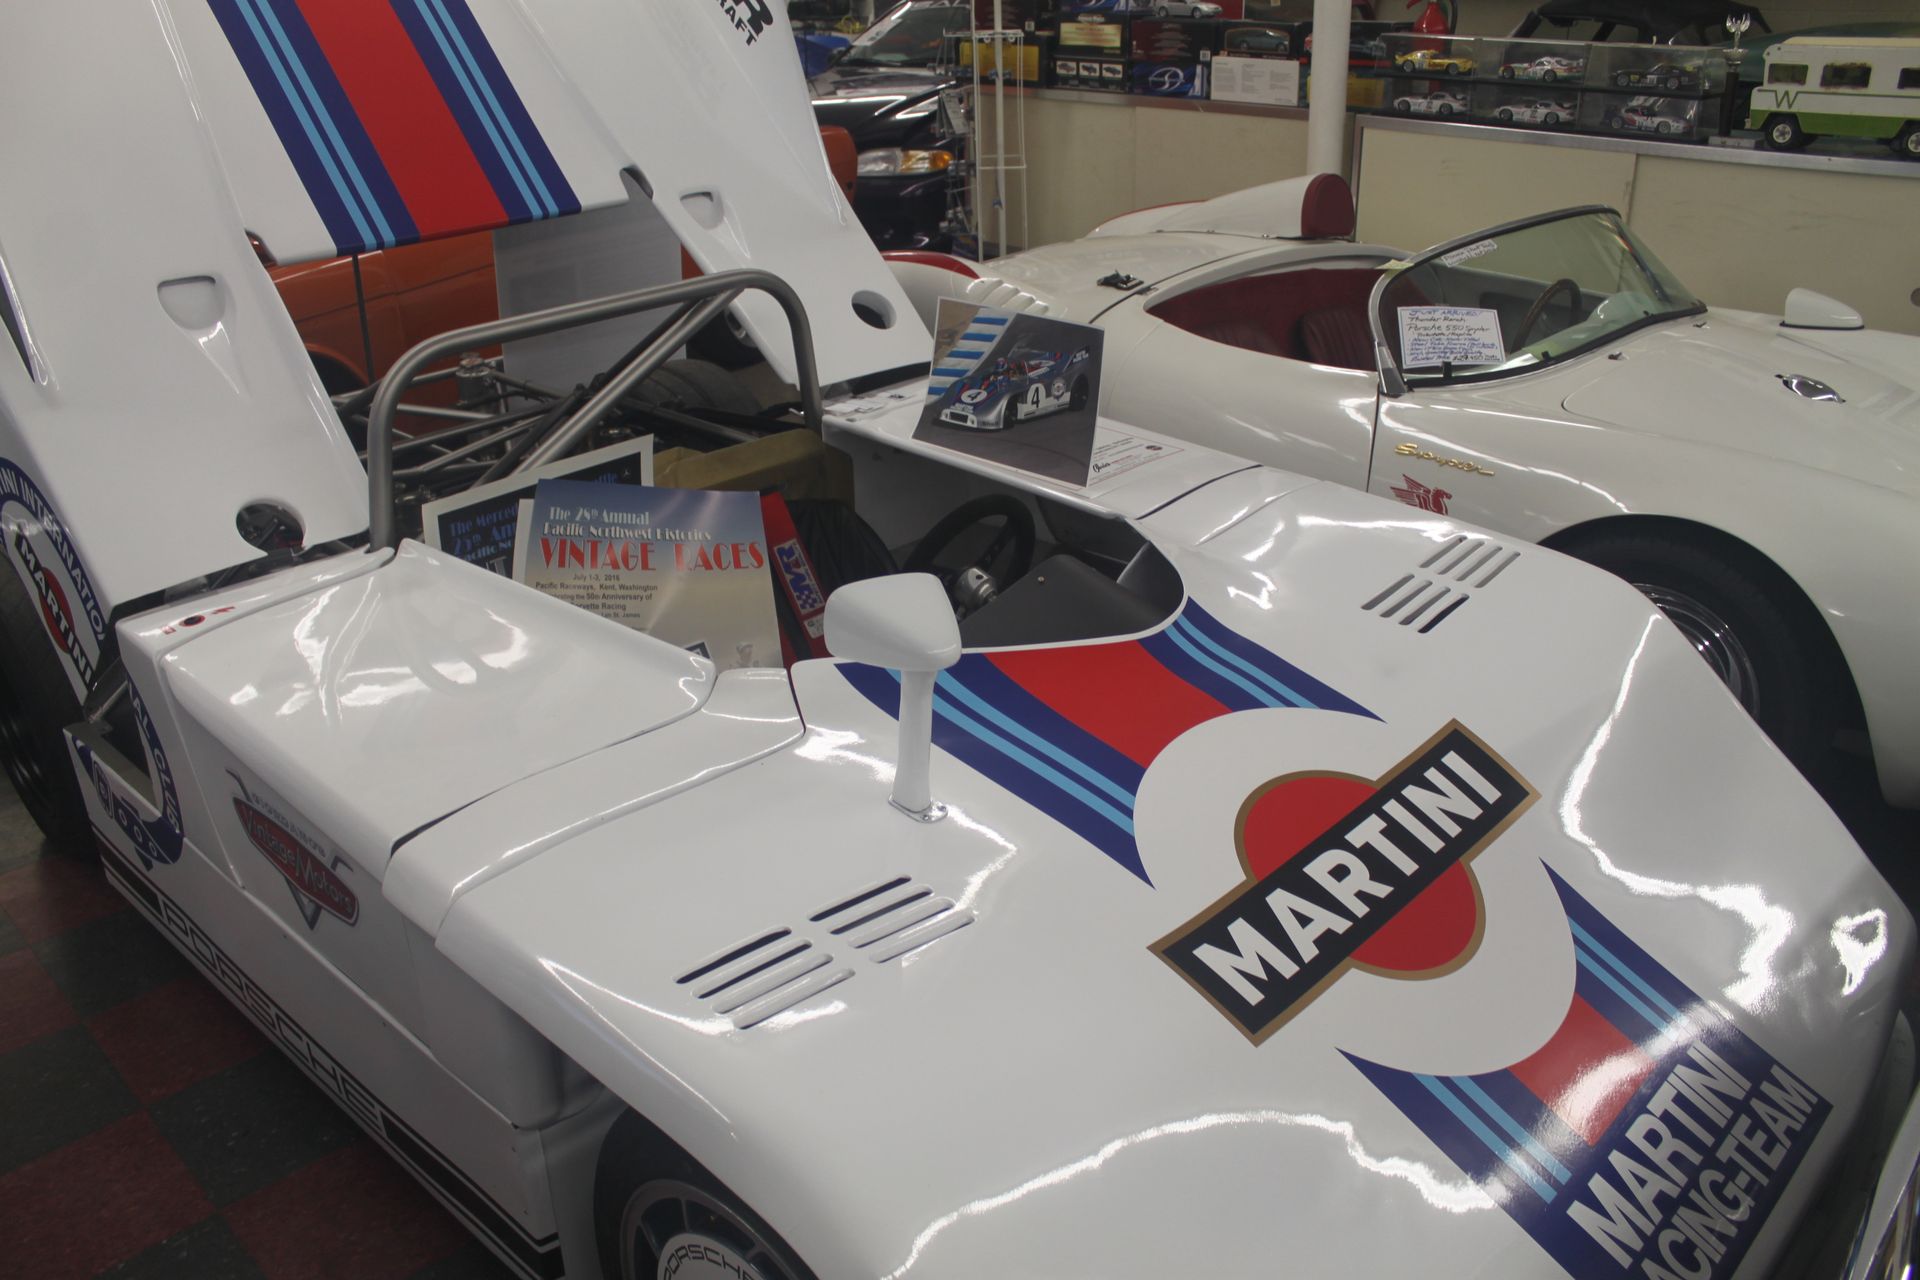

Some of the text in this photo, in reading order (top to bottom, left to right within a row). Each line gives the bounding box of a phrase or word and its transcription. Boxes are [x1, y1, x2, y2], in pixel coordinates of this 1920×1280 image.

[543, 521, 712, 541] Pacific Northwest Historics
[549, 506, 571, 520] The
[602, 508, 650, 525] Annual
[540, 538, 656, 571] VINTAGE
[674, 541, 764, 571] RACES
[535, 581, 557, 590] Pacific
[619, 584, 658, 593] Washington
[601, 593, 644, 602] Anniversary
[20, 537, 93, 685] MARTINI
[601, 602, 627, 611] Racing
[152, 747, 182, 836] CLUB
[1192, 750, 1503, 1007] MARTINI
[161, 900, 381, 1124] PORSCHE
[1566, 1043, 1753, 1270] MARTINI
